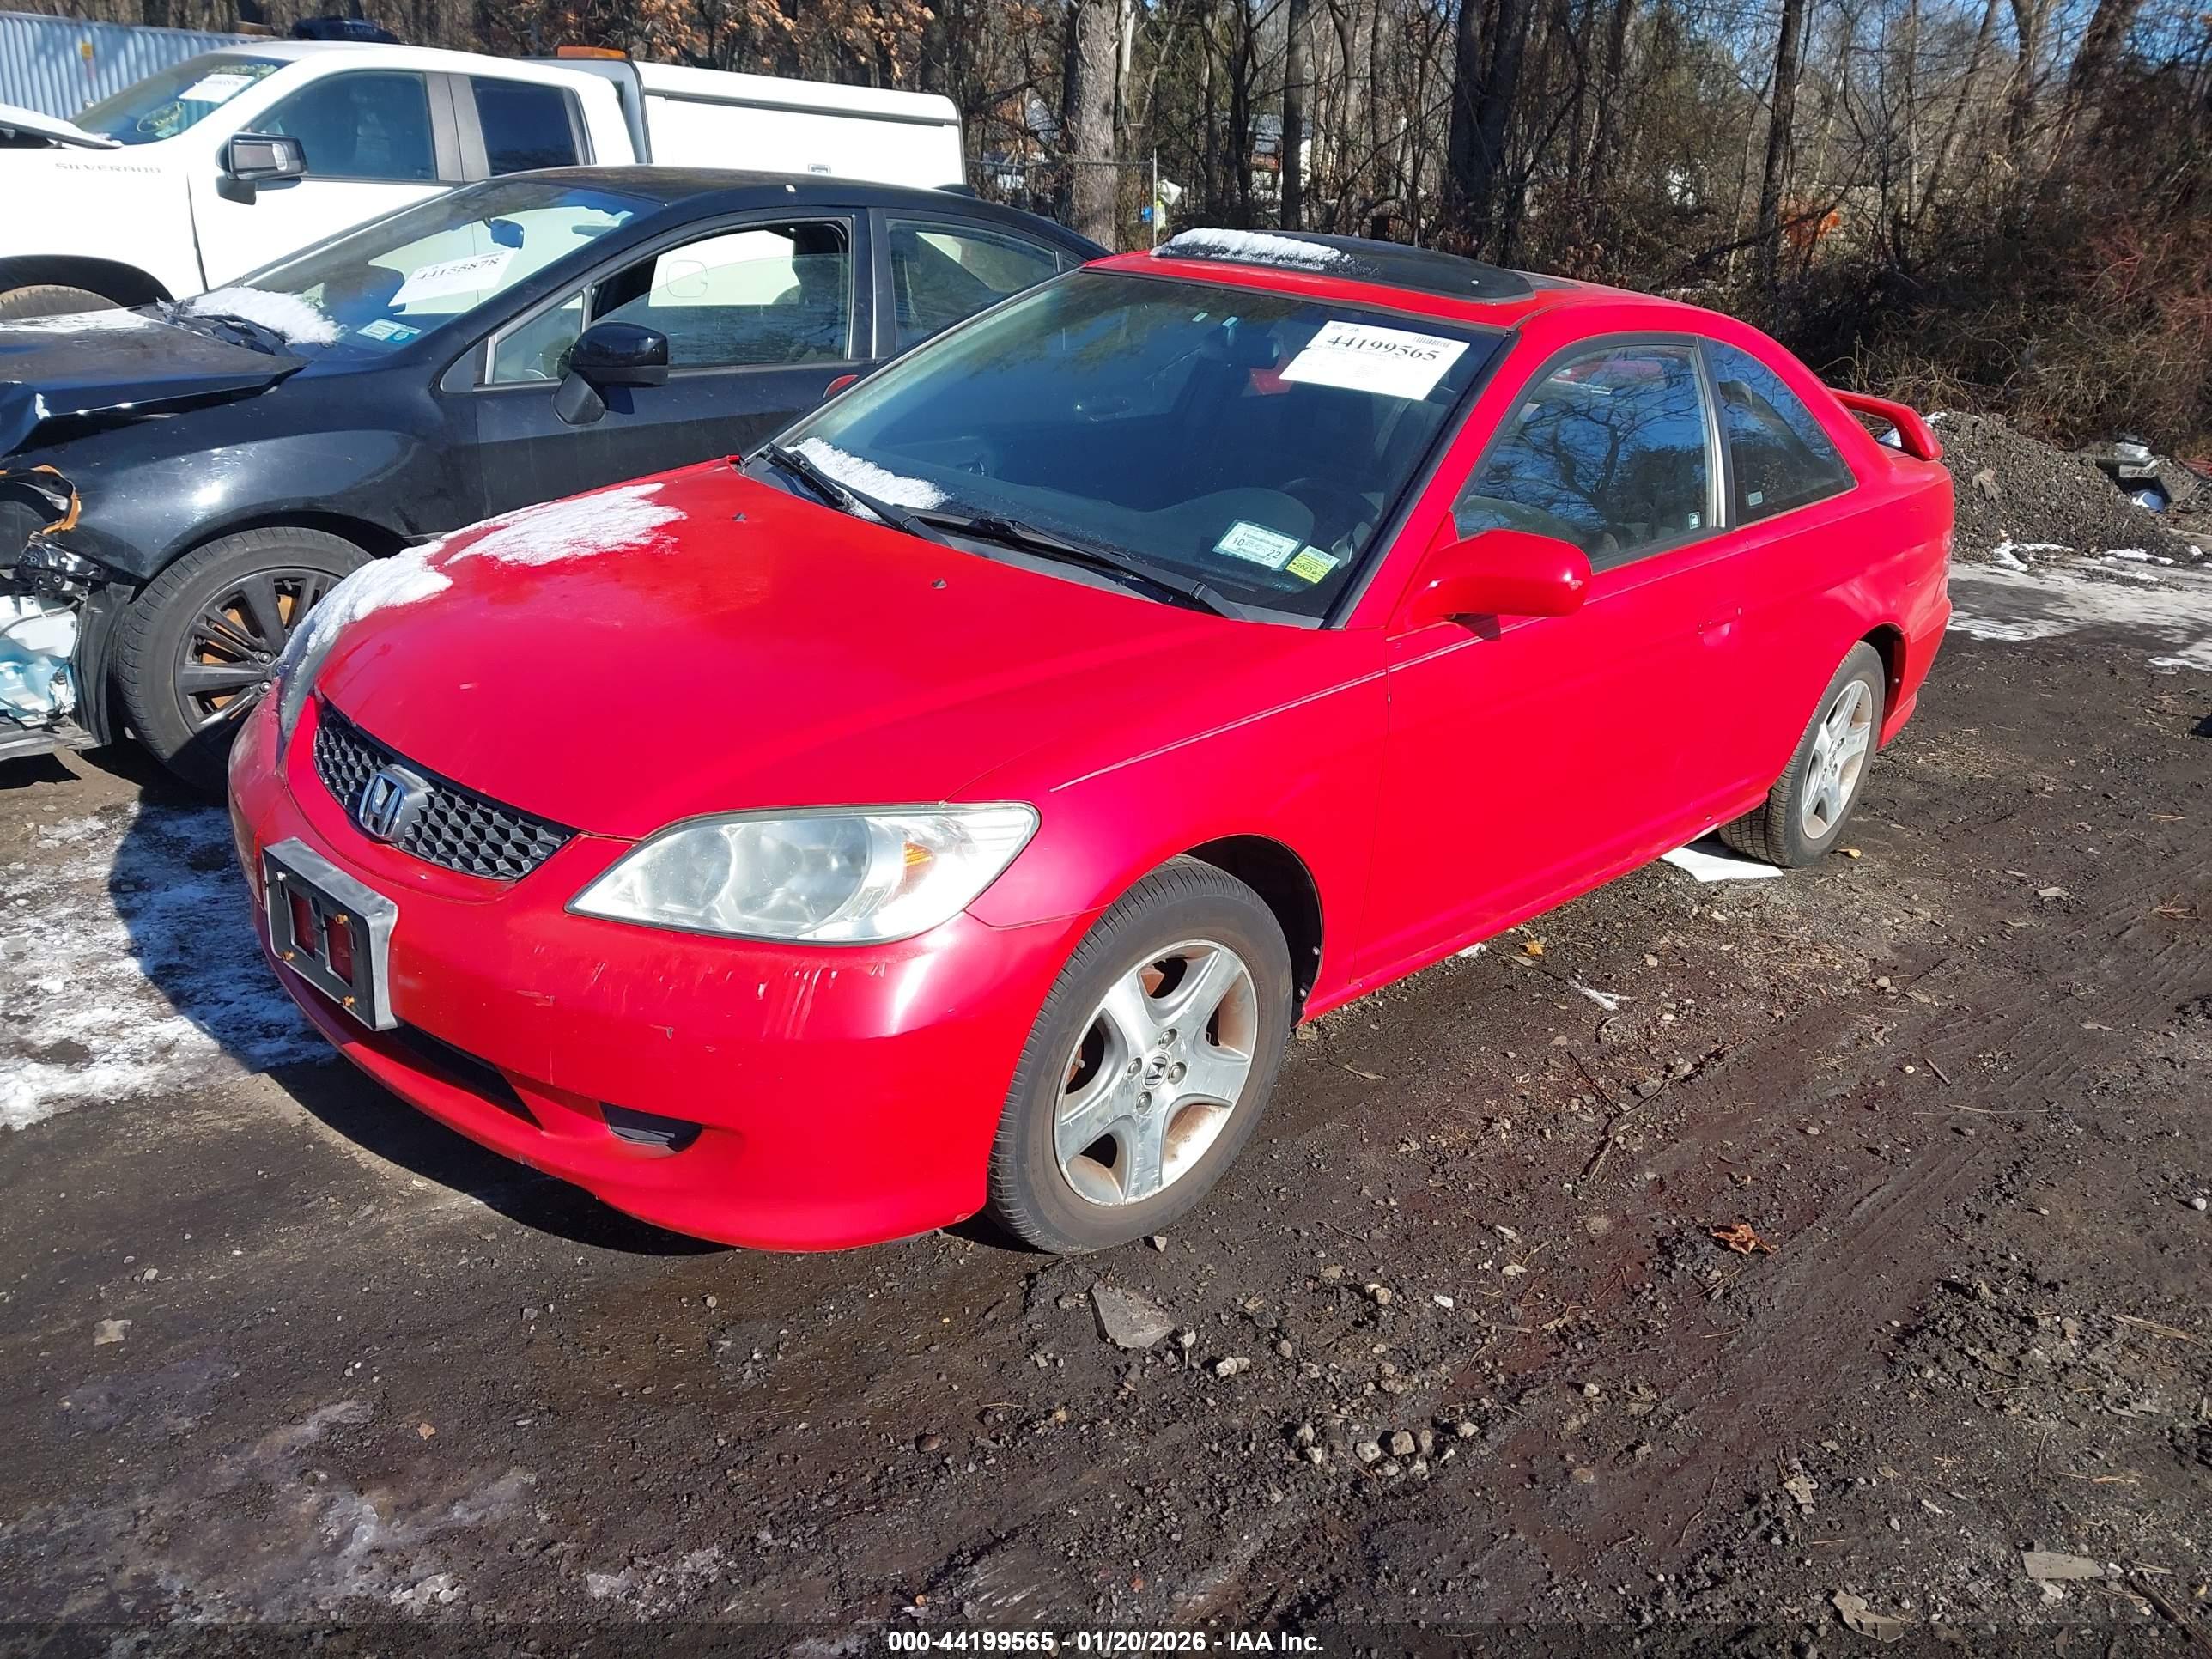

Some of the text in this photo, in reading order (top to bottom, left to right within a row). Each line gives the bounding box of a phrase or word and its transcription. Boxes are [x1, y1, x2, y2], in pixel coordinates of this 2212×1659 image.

[54, 161, 162, 174] SILVERADO
[1328, 336, 1439, 361] 44199565
[1231, 536, 1245, 547] 10
[1267, 548, 1282, 560] 22
